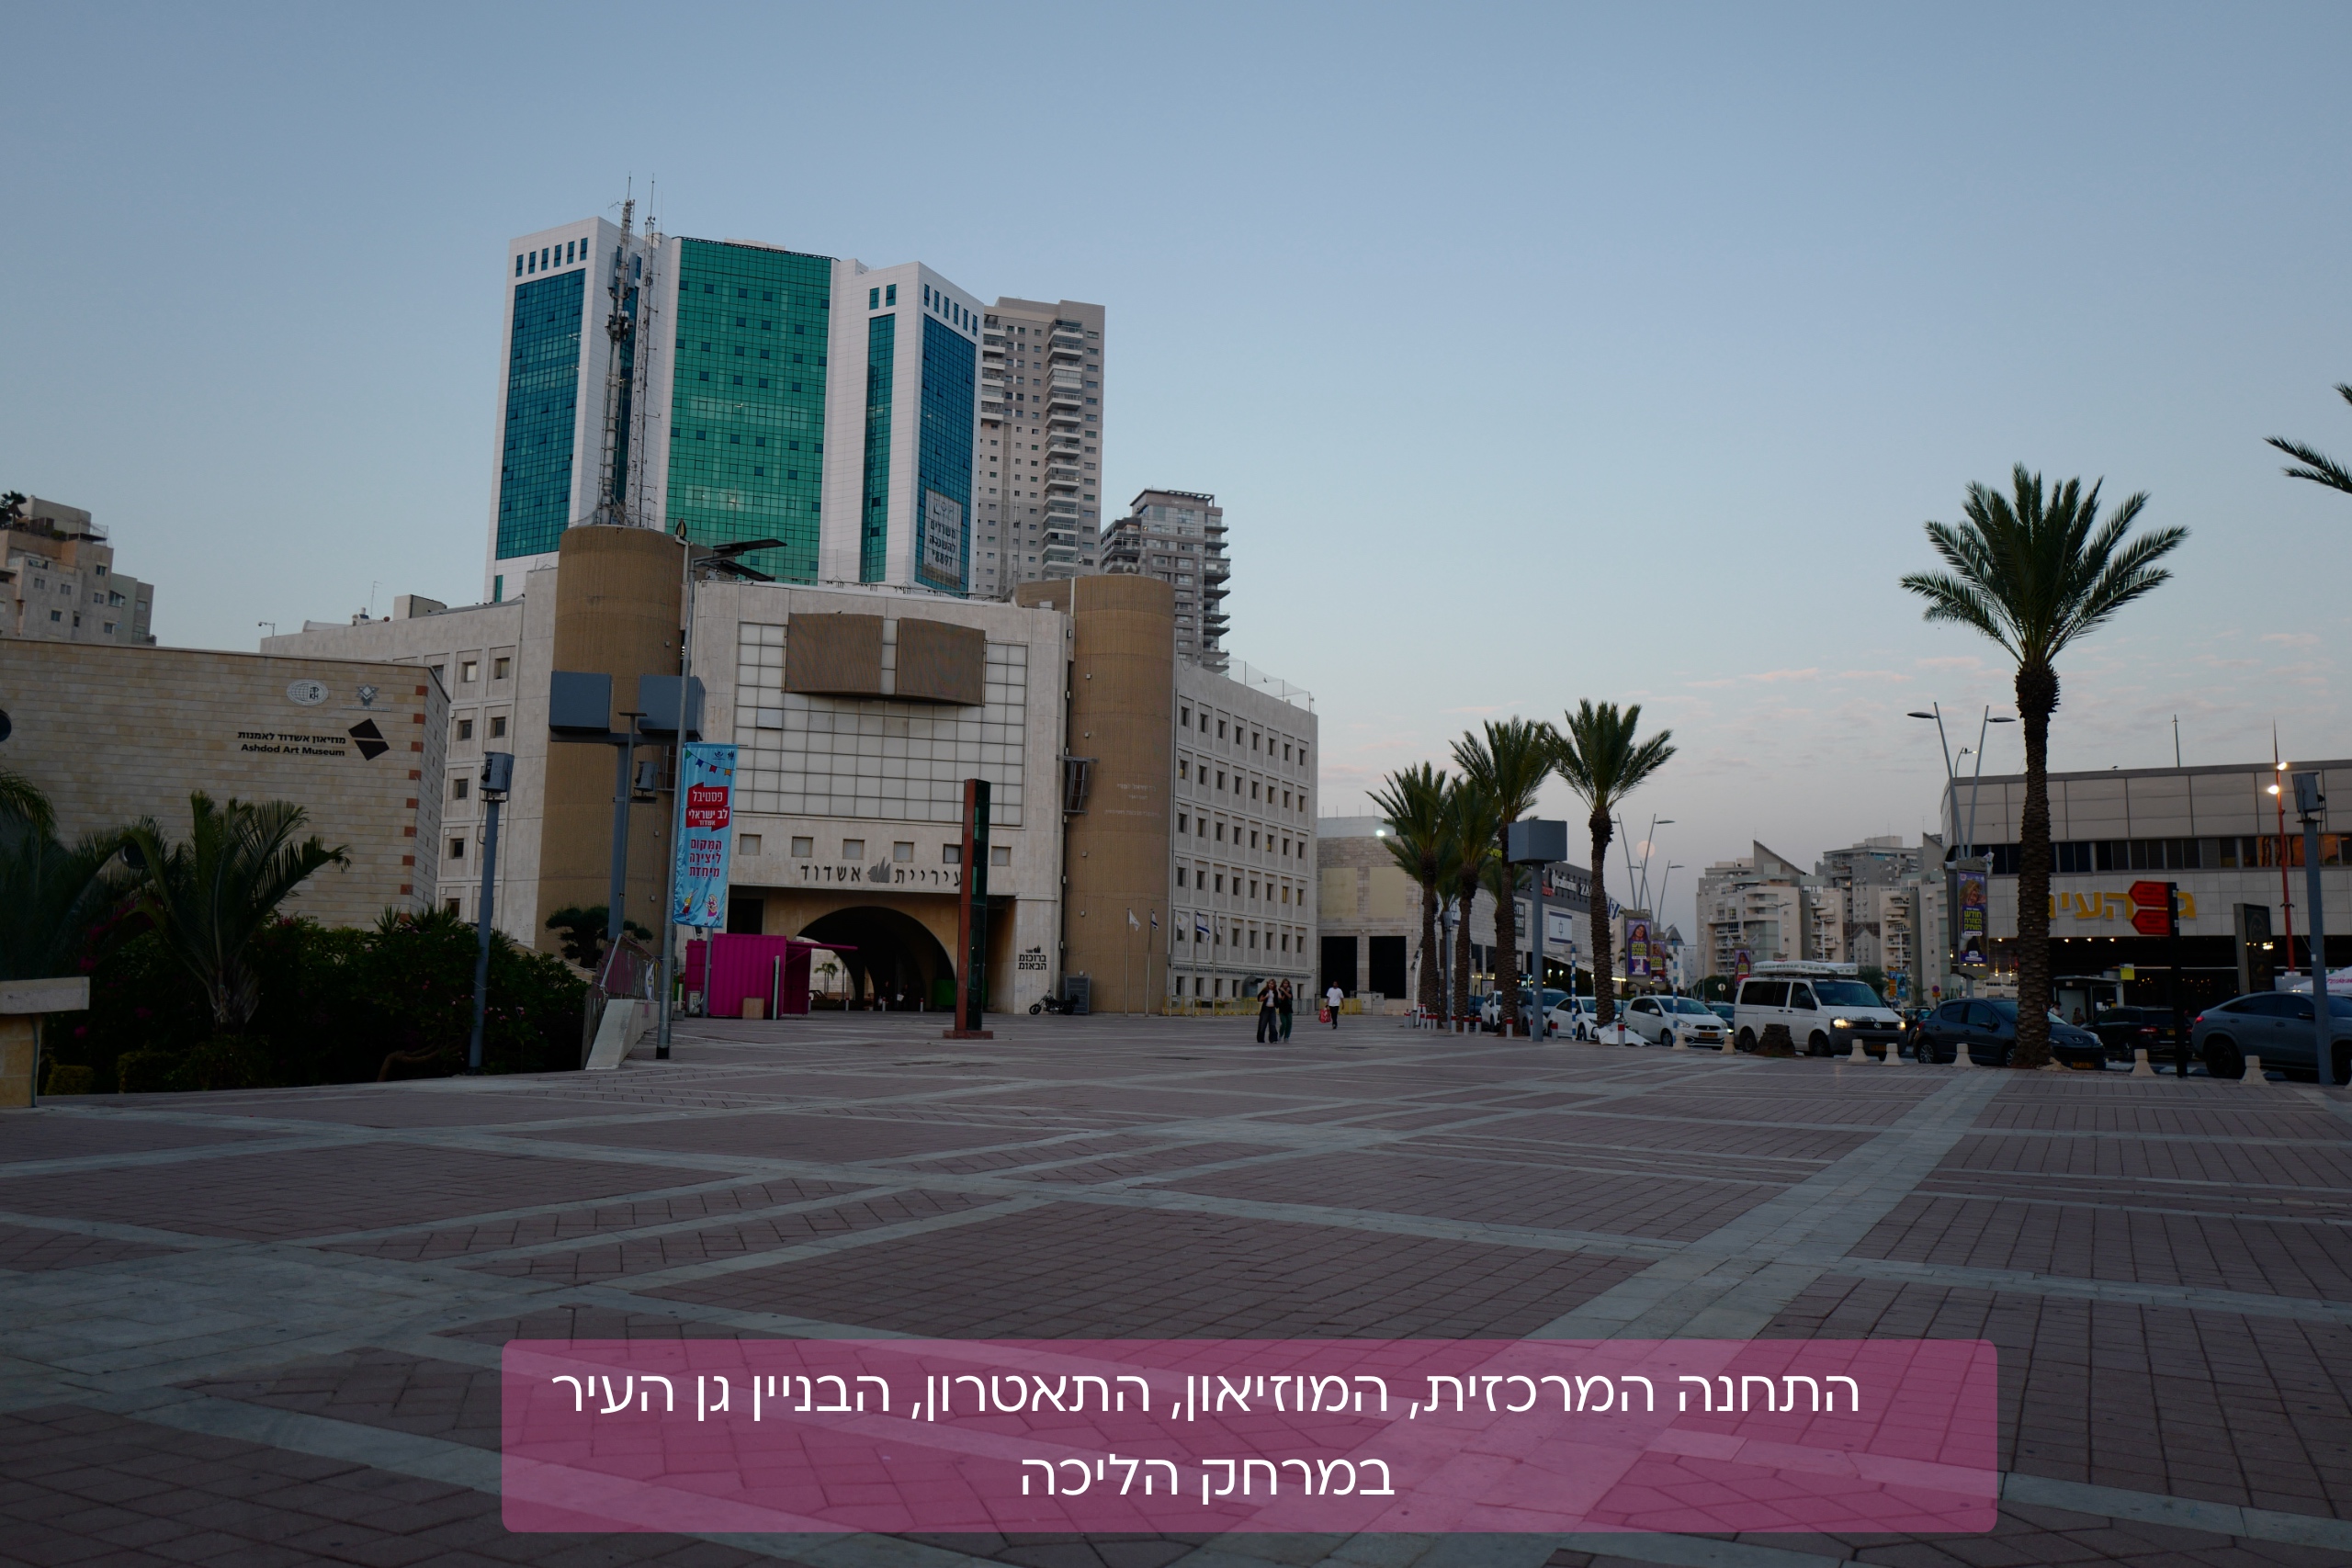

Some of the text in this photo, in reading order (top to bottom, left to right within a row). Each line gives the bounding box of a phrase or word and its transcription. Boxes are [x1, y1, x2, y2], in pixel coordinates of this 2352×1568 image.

[930, 520, 956, 539] משרדים
[238, 731, 346, 744] מוזיאון אשדוד לאמנות
[241, 743, 345, 756] Ashdod Art Museum
[693, 790, 723, 802] פסטיבל
[688, 808, 729, 819] לב ישראלי
[800, 865, 962, 886] עיריית אשדוד
[1580, 882, 1592, 897] ZA
